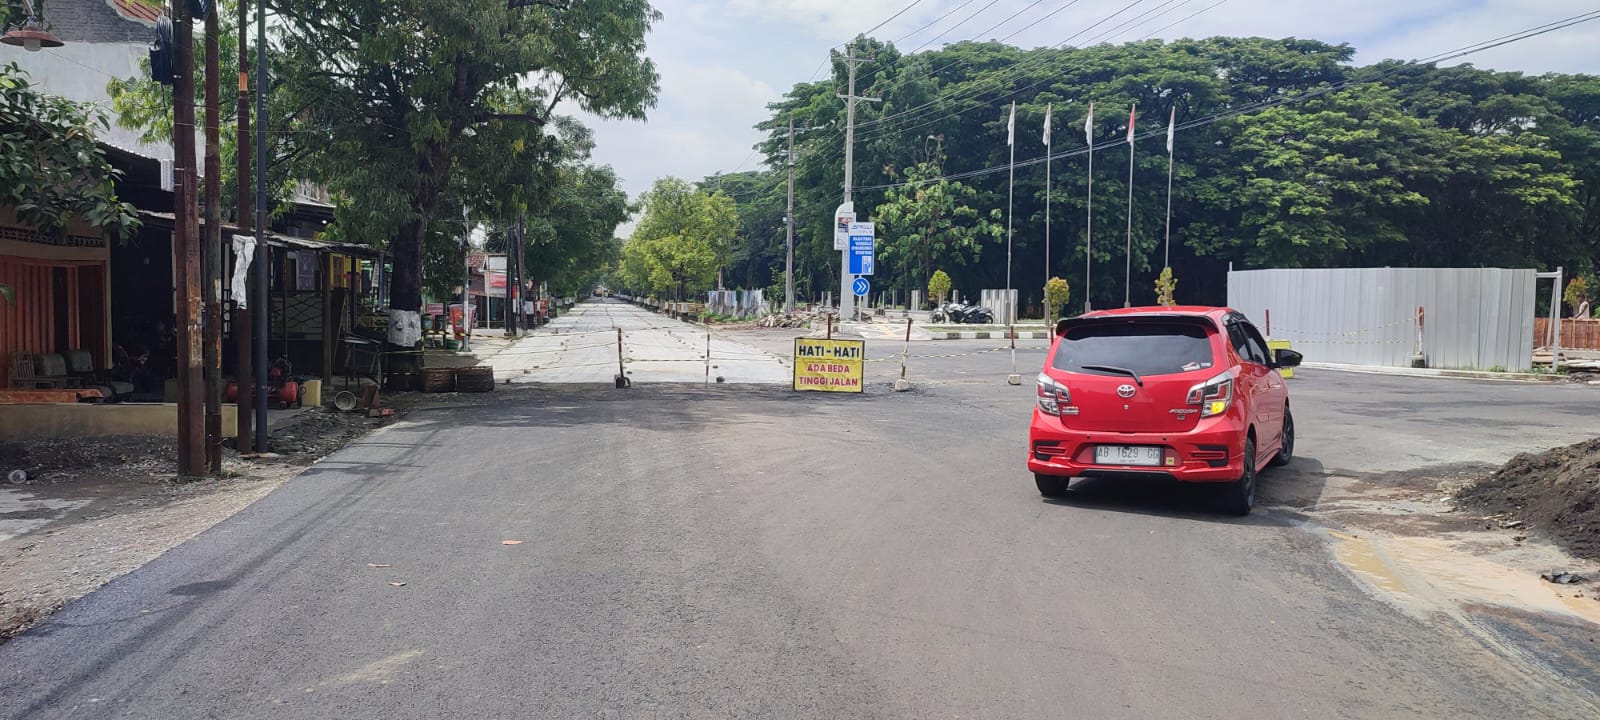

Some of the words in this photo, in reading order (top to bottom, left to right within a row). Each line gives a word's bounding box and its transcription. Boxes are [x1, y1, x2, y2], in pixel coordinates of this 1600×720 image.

[798, 345, 824, 356] HATI
[833, 347, 859, 358] HATI
[807, 364, 826, 373] ADA
[827, 364, 850, 373] BEDA
[799, 376, 828, 385] TINGGI
[829, 377, 858, 387] JALAN
[1097, 446, 1109, 458] AB
[1117, 447, 1139, 459] 1629
